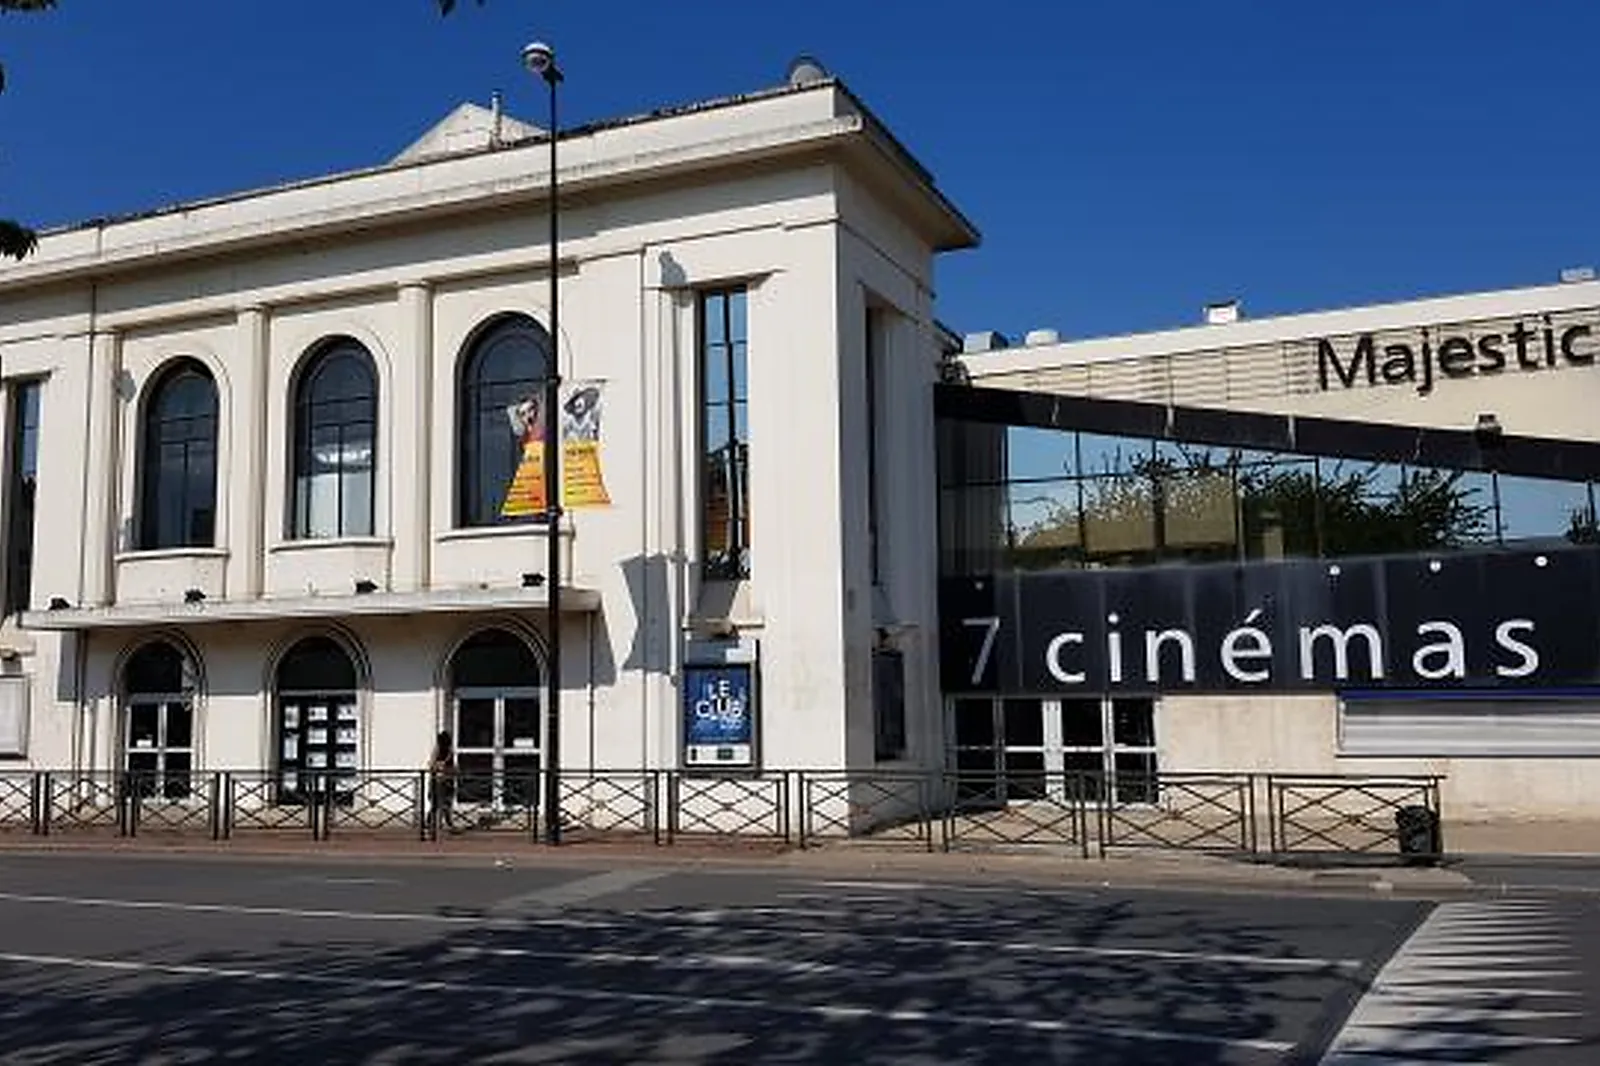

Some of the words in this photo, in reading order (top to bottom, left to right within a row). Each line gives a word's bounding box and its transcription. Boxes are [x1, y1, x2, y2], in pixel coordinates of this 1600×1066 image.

[1318, 314, 1596, 396] Majestic
[962, 616, 1000, 685] 7
[1046, 608, 1540, 683] cinémas
[708, 680, 731, 699] LE
